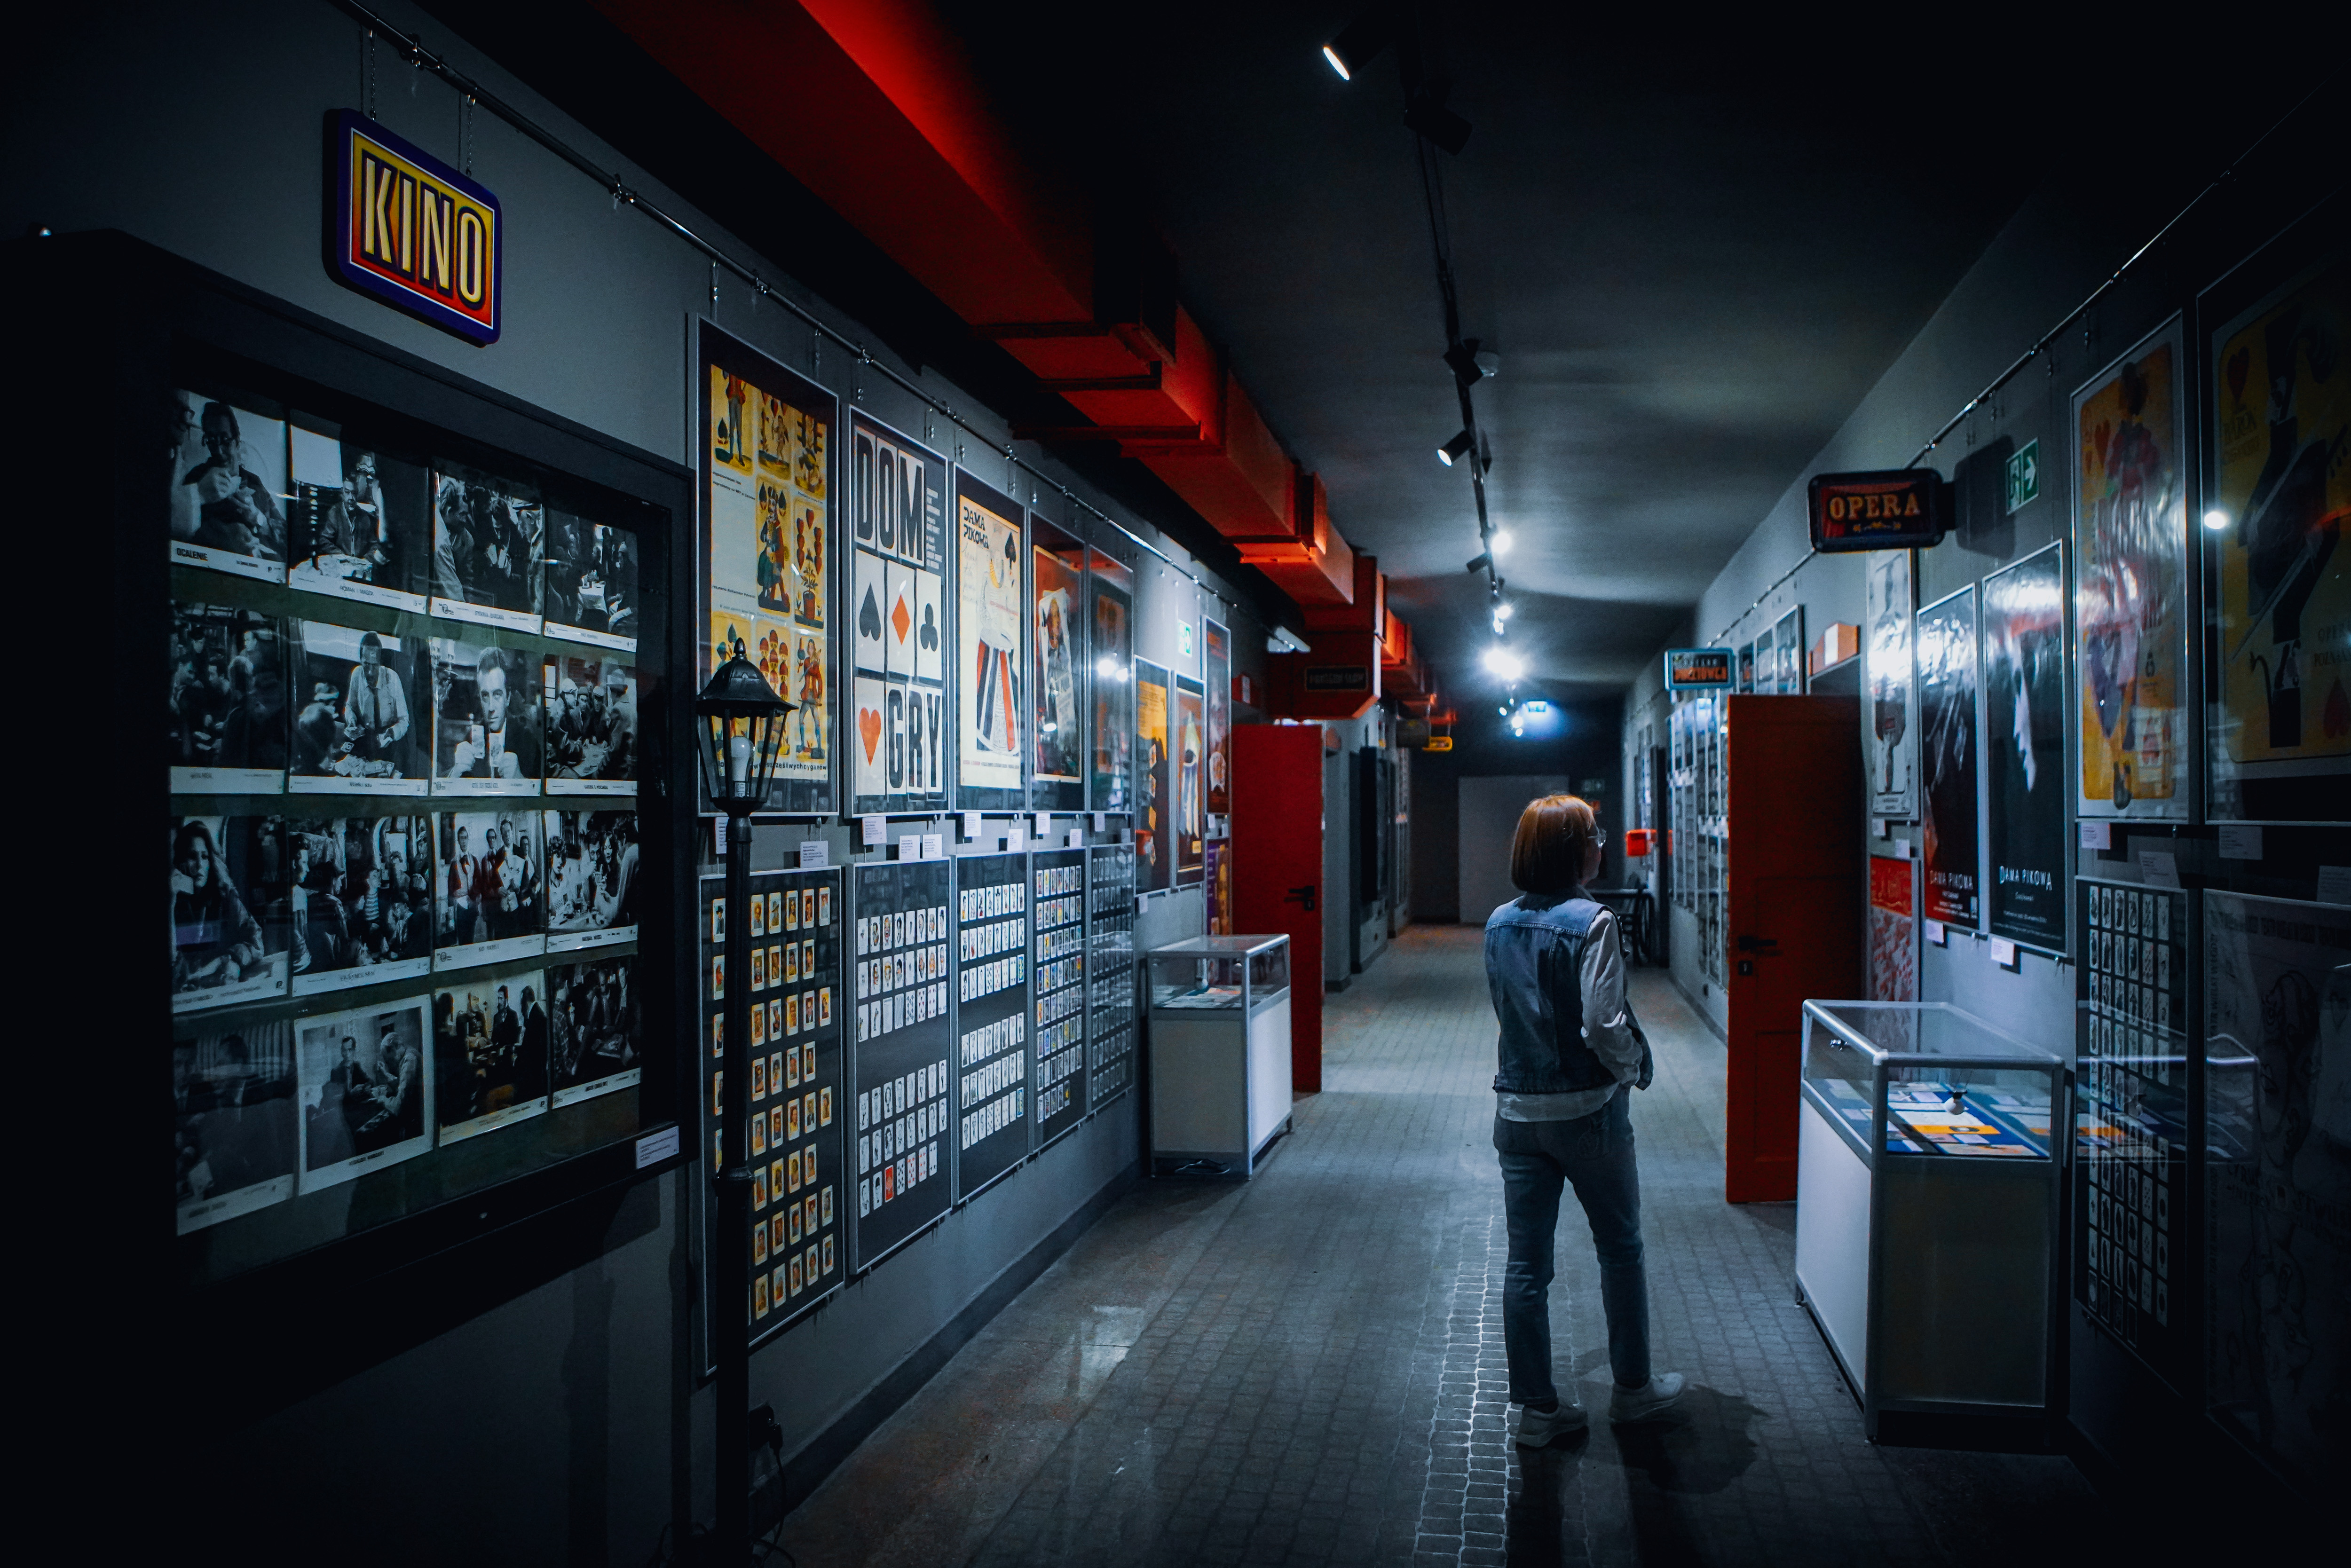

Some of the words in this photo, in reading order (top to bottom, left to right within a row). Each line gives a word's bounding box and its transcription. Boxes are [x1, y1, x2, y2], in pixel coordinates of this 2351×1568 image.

[362, 152, 484, 306] KINO
[857, 433, 923, 561] DOM
[1829, 492, 1921, 521] OPERA
[964, 506, 986, 531] DAMA
[964, 523, 989, 549] PIKOWA
[888, 689, 940, 788] GRY
[1999, 865, 2020, 884] DAMA
[2022, 869, 2052, 891] PIKOWA
